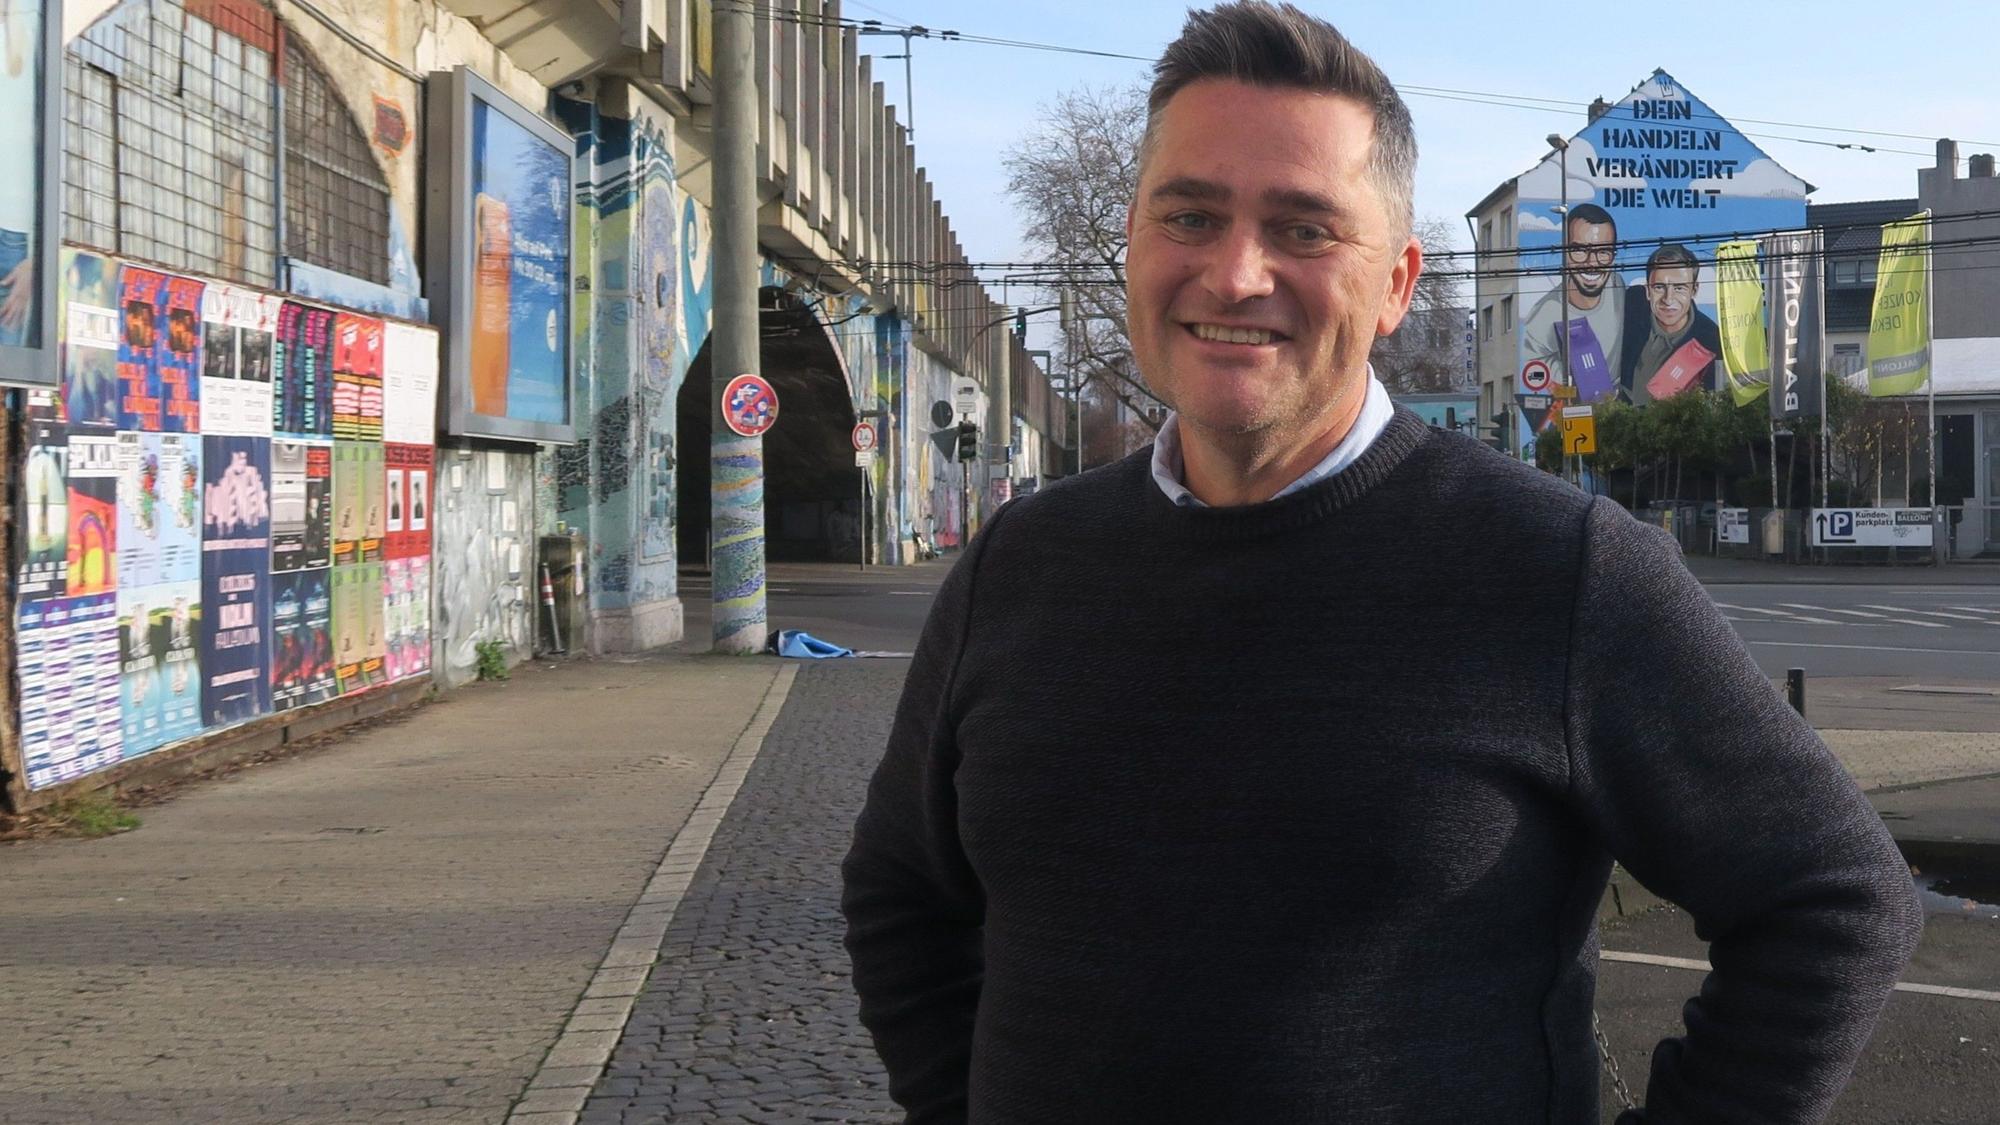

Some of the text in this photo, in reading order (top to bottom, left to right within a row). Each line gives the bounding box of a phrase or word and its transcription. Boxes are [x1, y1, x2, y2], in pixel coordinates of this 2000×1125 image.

[1633, 99, 1691, 120] DEIN
[1603, 128, 1721, 151] HANDELN
[1586, 153, 1738, 179] VERÄNDERT
[1604, 187, 1721, 209] DIE WELT
[1565, 421, 1573, 431] U
[1834, 514, 1850, 534] P
[1855, 518, 1893, 527] parkplatz
